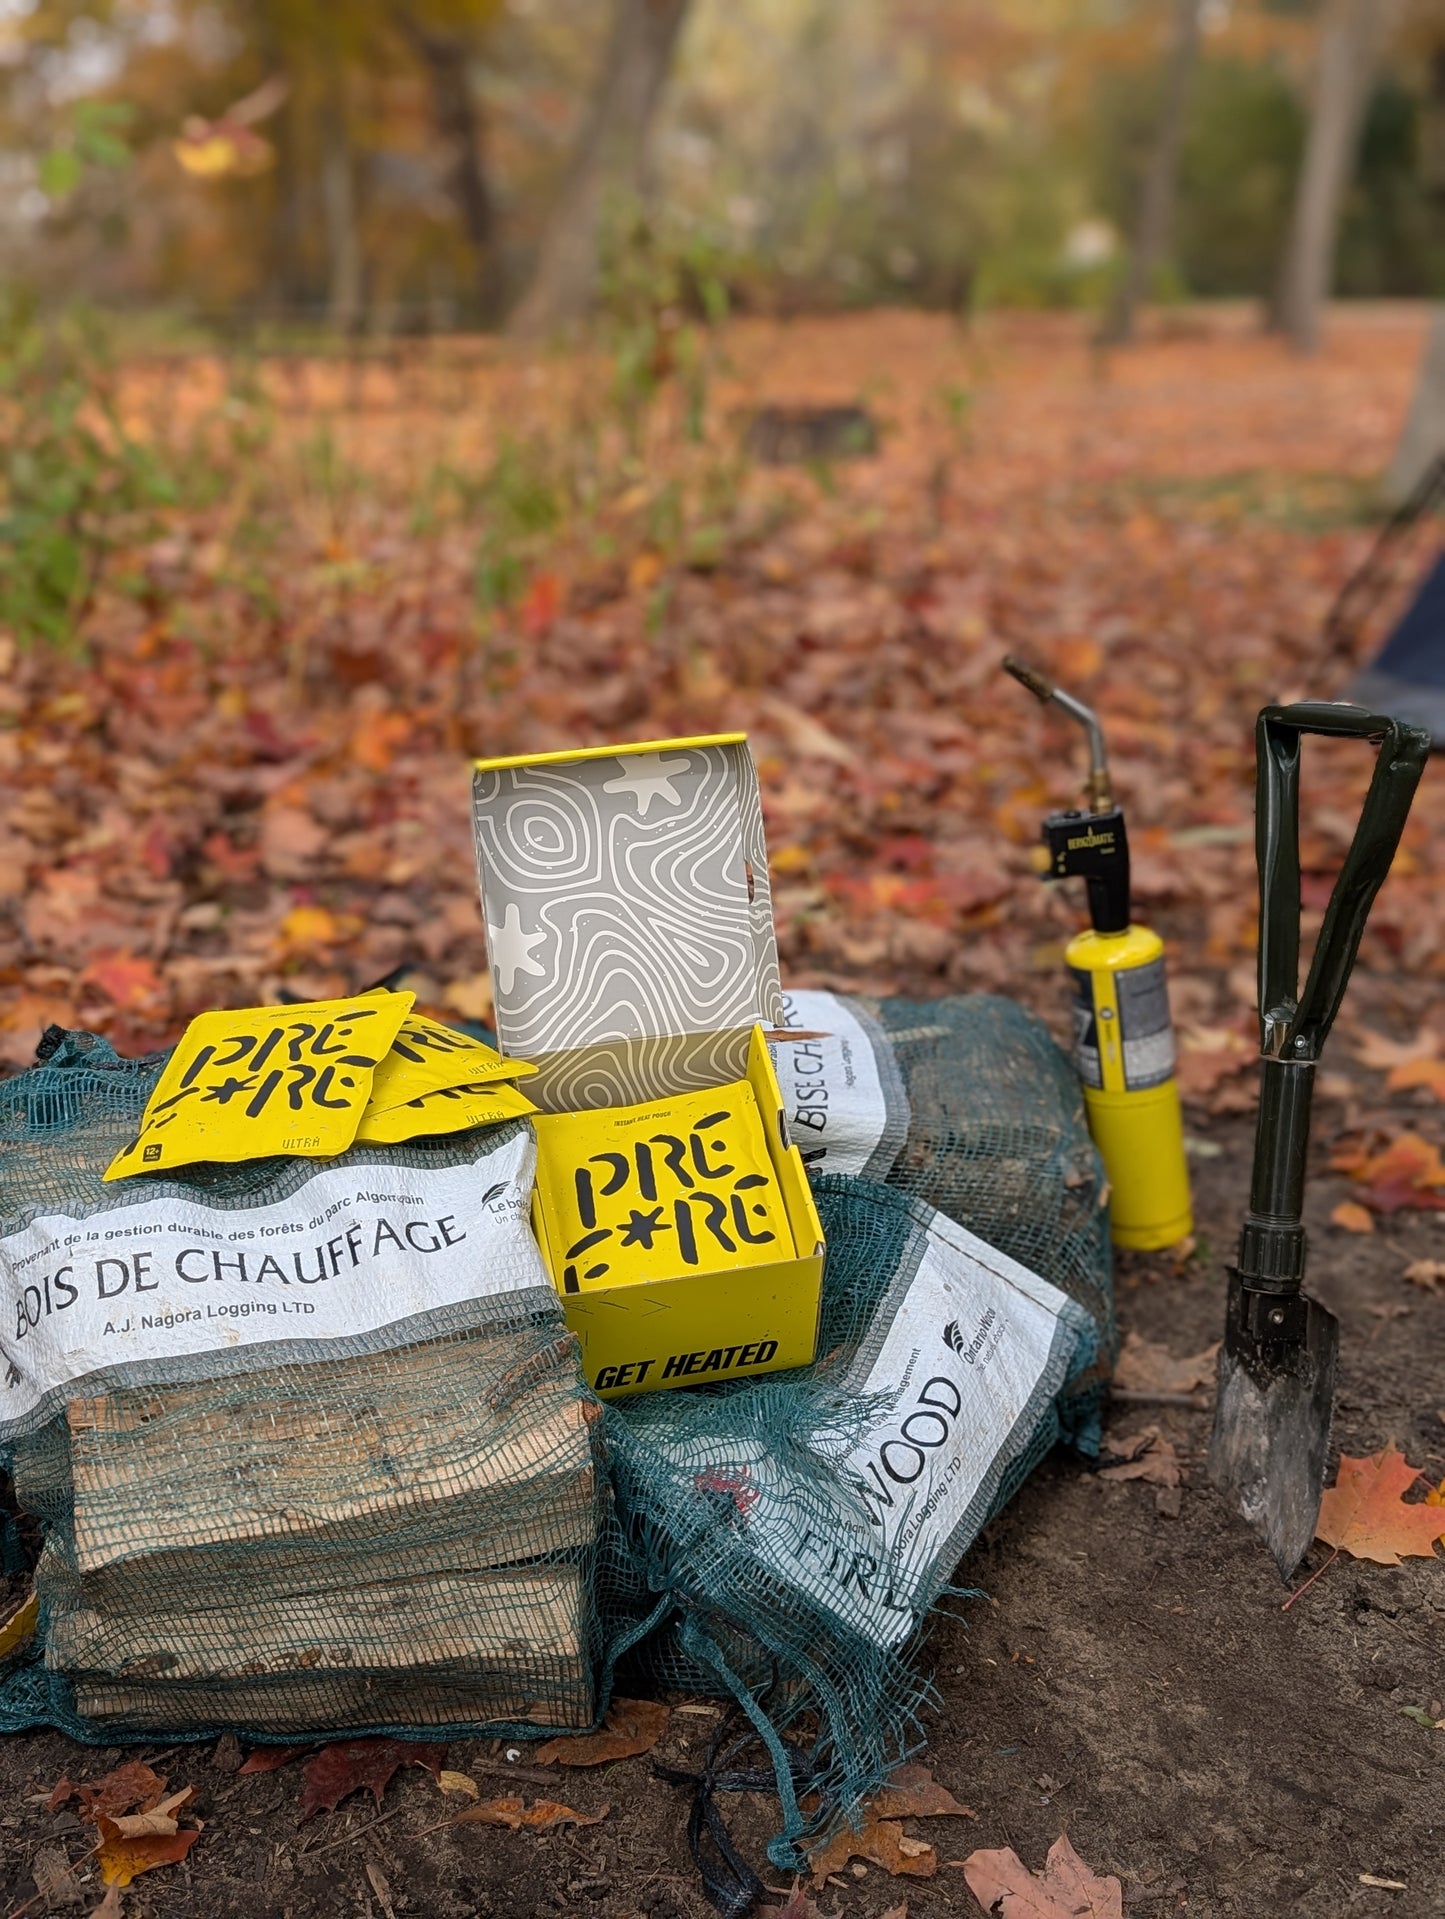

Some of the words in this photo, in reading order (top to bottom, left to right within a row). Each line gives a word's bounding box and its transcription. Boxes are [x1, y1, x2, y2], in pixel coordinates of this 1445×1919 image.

[180, 1010, 378, 1088] PRE
[282, 1136, 321, 1150] ULTRA
[575, 1111, 735, 1229] PRE
[64, 1234, 82, 1247] de
[86, 1231, 100, 1241] la
[104, 1222, 163, 1241] gestion
[167, 1222, 224, 1240] durable
[228, 1224, 256, 1241] des
[259, 1222, 304, 1238] forêts
[308, 1211, 325, 1230] du
[325, 1197, 351, 1222] parc
[488, 1202, 506, 1214] Le
[16, 1266, 79, 1341] BOIS
[94, 1252, 160, 1300] DE
[175, 1215, 467, 1285] CHAUFFAGE
[102, 1320, 136, 1336] A.J.
[142, 1309, 201, 1330] Nagora
[207, 1301, 277, 1318] Logging
[283, 1302, 315, 1314] LTD
[594, 1359, 656, 1391] GET
[661, 1340, 779, 1380] HEATED
[943, 1456, 962, 1484] LTD
